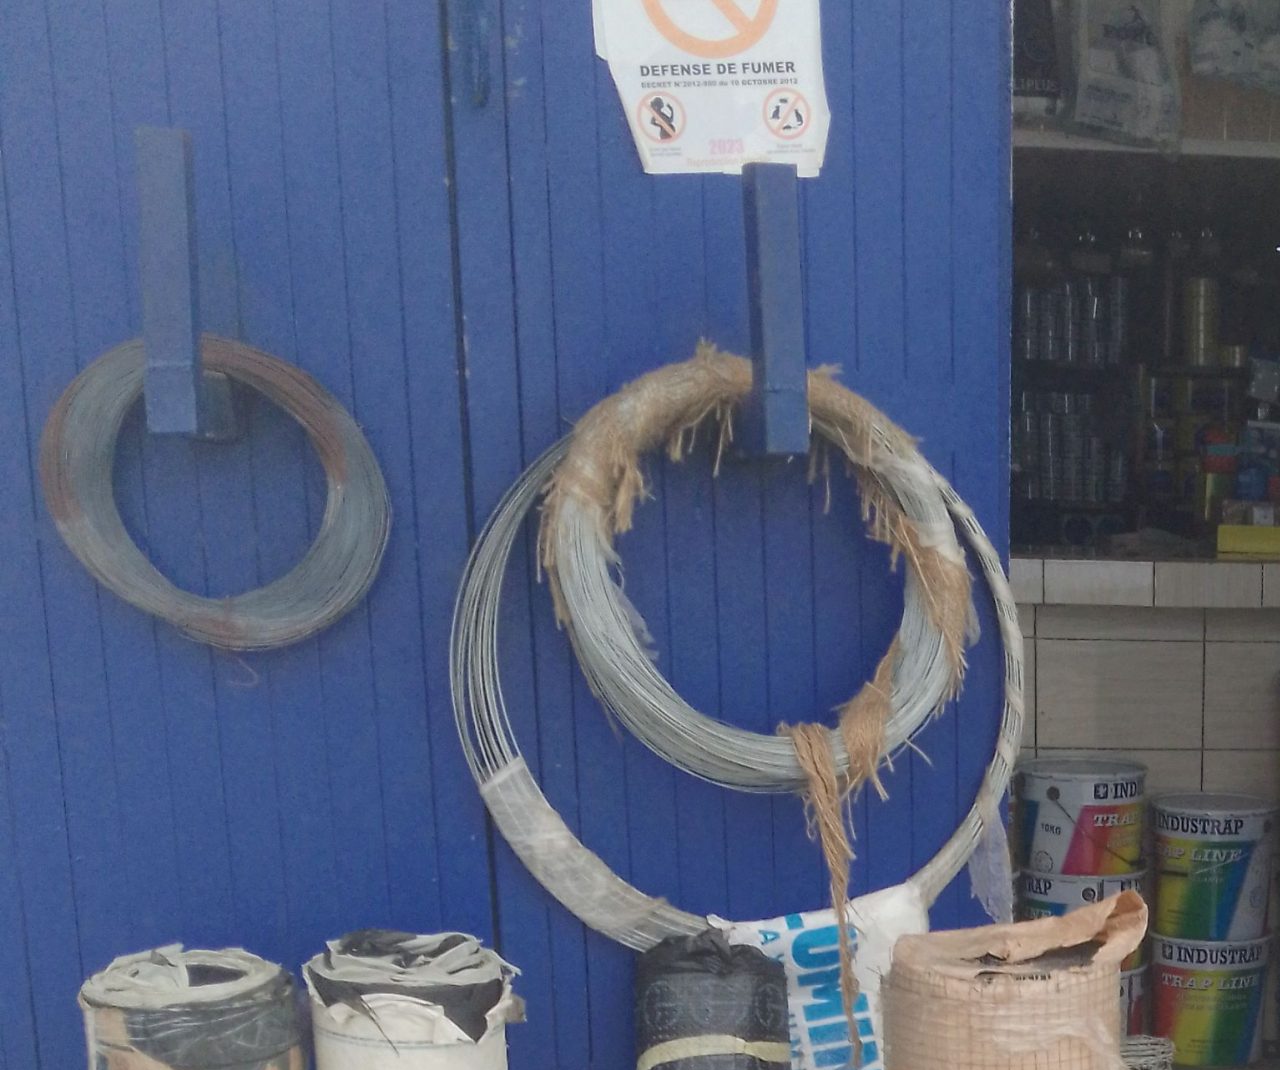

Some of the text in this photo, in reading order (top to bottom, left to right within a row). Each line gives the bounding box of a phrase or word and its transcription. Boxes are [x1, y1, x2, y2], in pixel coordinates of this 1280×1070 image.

[640, 61, 796, 77] DEFENSE DE FUMER
[1040, 823, 1062, 836] 10KG
[1154, 811, 1245, 836] INDUSTRAP
[1189, 846, 1243, 862] LINE
[1160, 972, 1213, 989] TRAP
